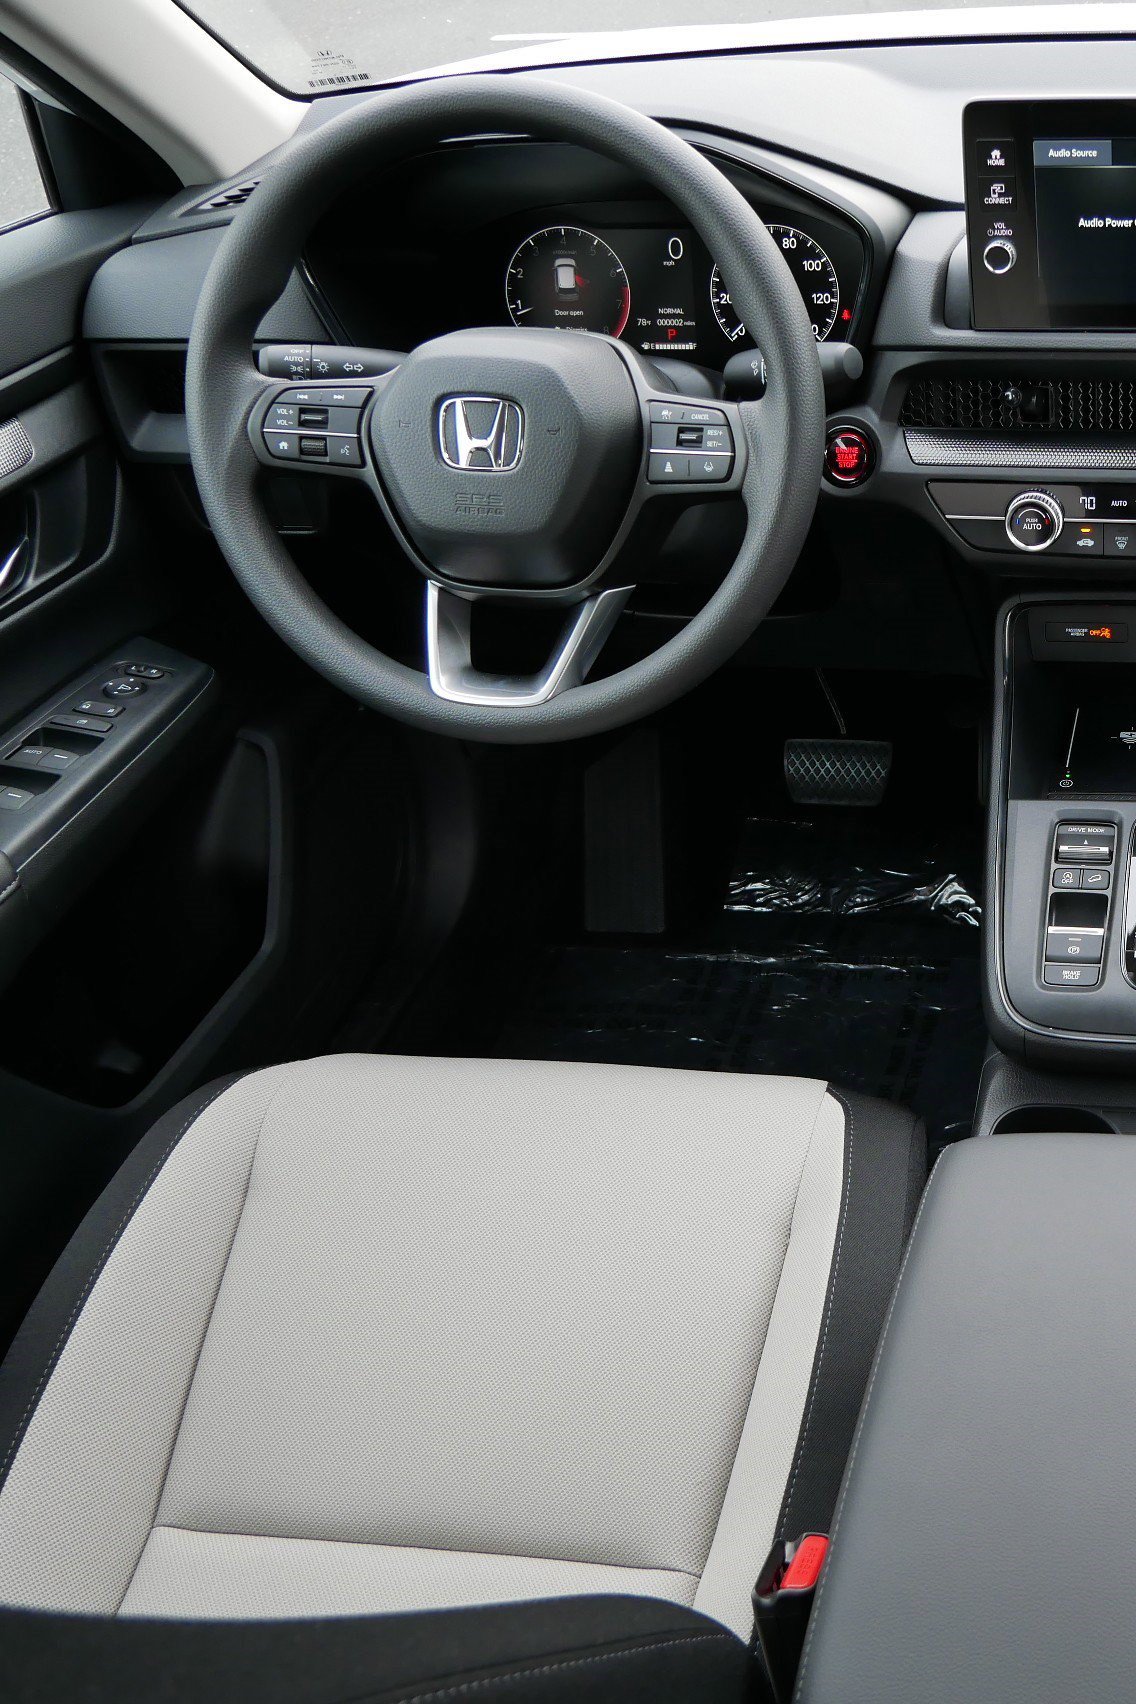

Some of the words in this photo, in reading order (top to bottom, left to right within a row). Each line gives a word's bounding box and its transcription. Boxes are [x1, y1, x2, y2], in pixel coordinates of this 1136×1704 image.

[1048, 148, 1070, 158] Audio
[1071, 149, 1097, 158] Source
[984, 197, 1013, 205] CONNECT
[1078, 218, 1104, 228] Audio
[1105, 218, 1132, 228] Power
[668, 237, 684, 260] 0
[782, 238, 797, 249] 80
[802, 260, 822, 271] 100
[516, 268, 524, 278] 2
[609, 268, 617, 278] 6
[811, 293, 831, 304] 120
[517, 300, 522, 309] 1
[668, 329, 677, 340] P
[835, 446, 859, 454] ENGINE
[1080, 496, 1096, 510] 70
